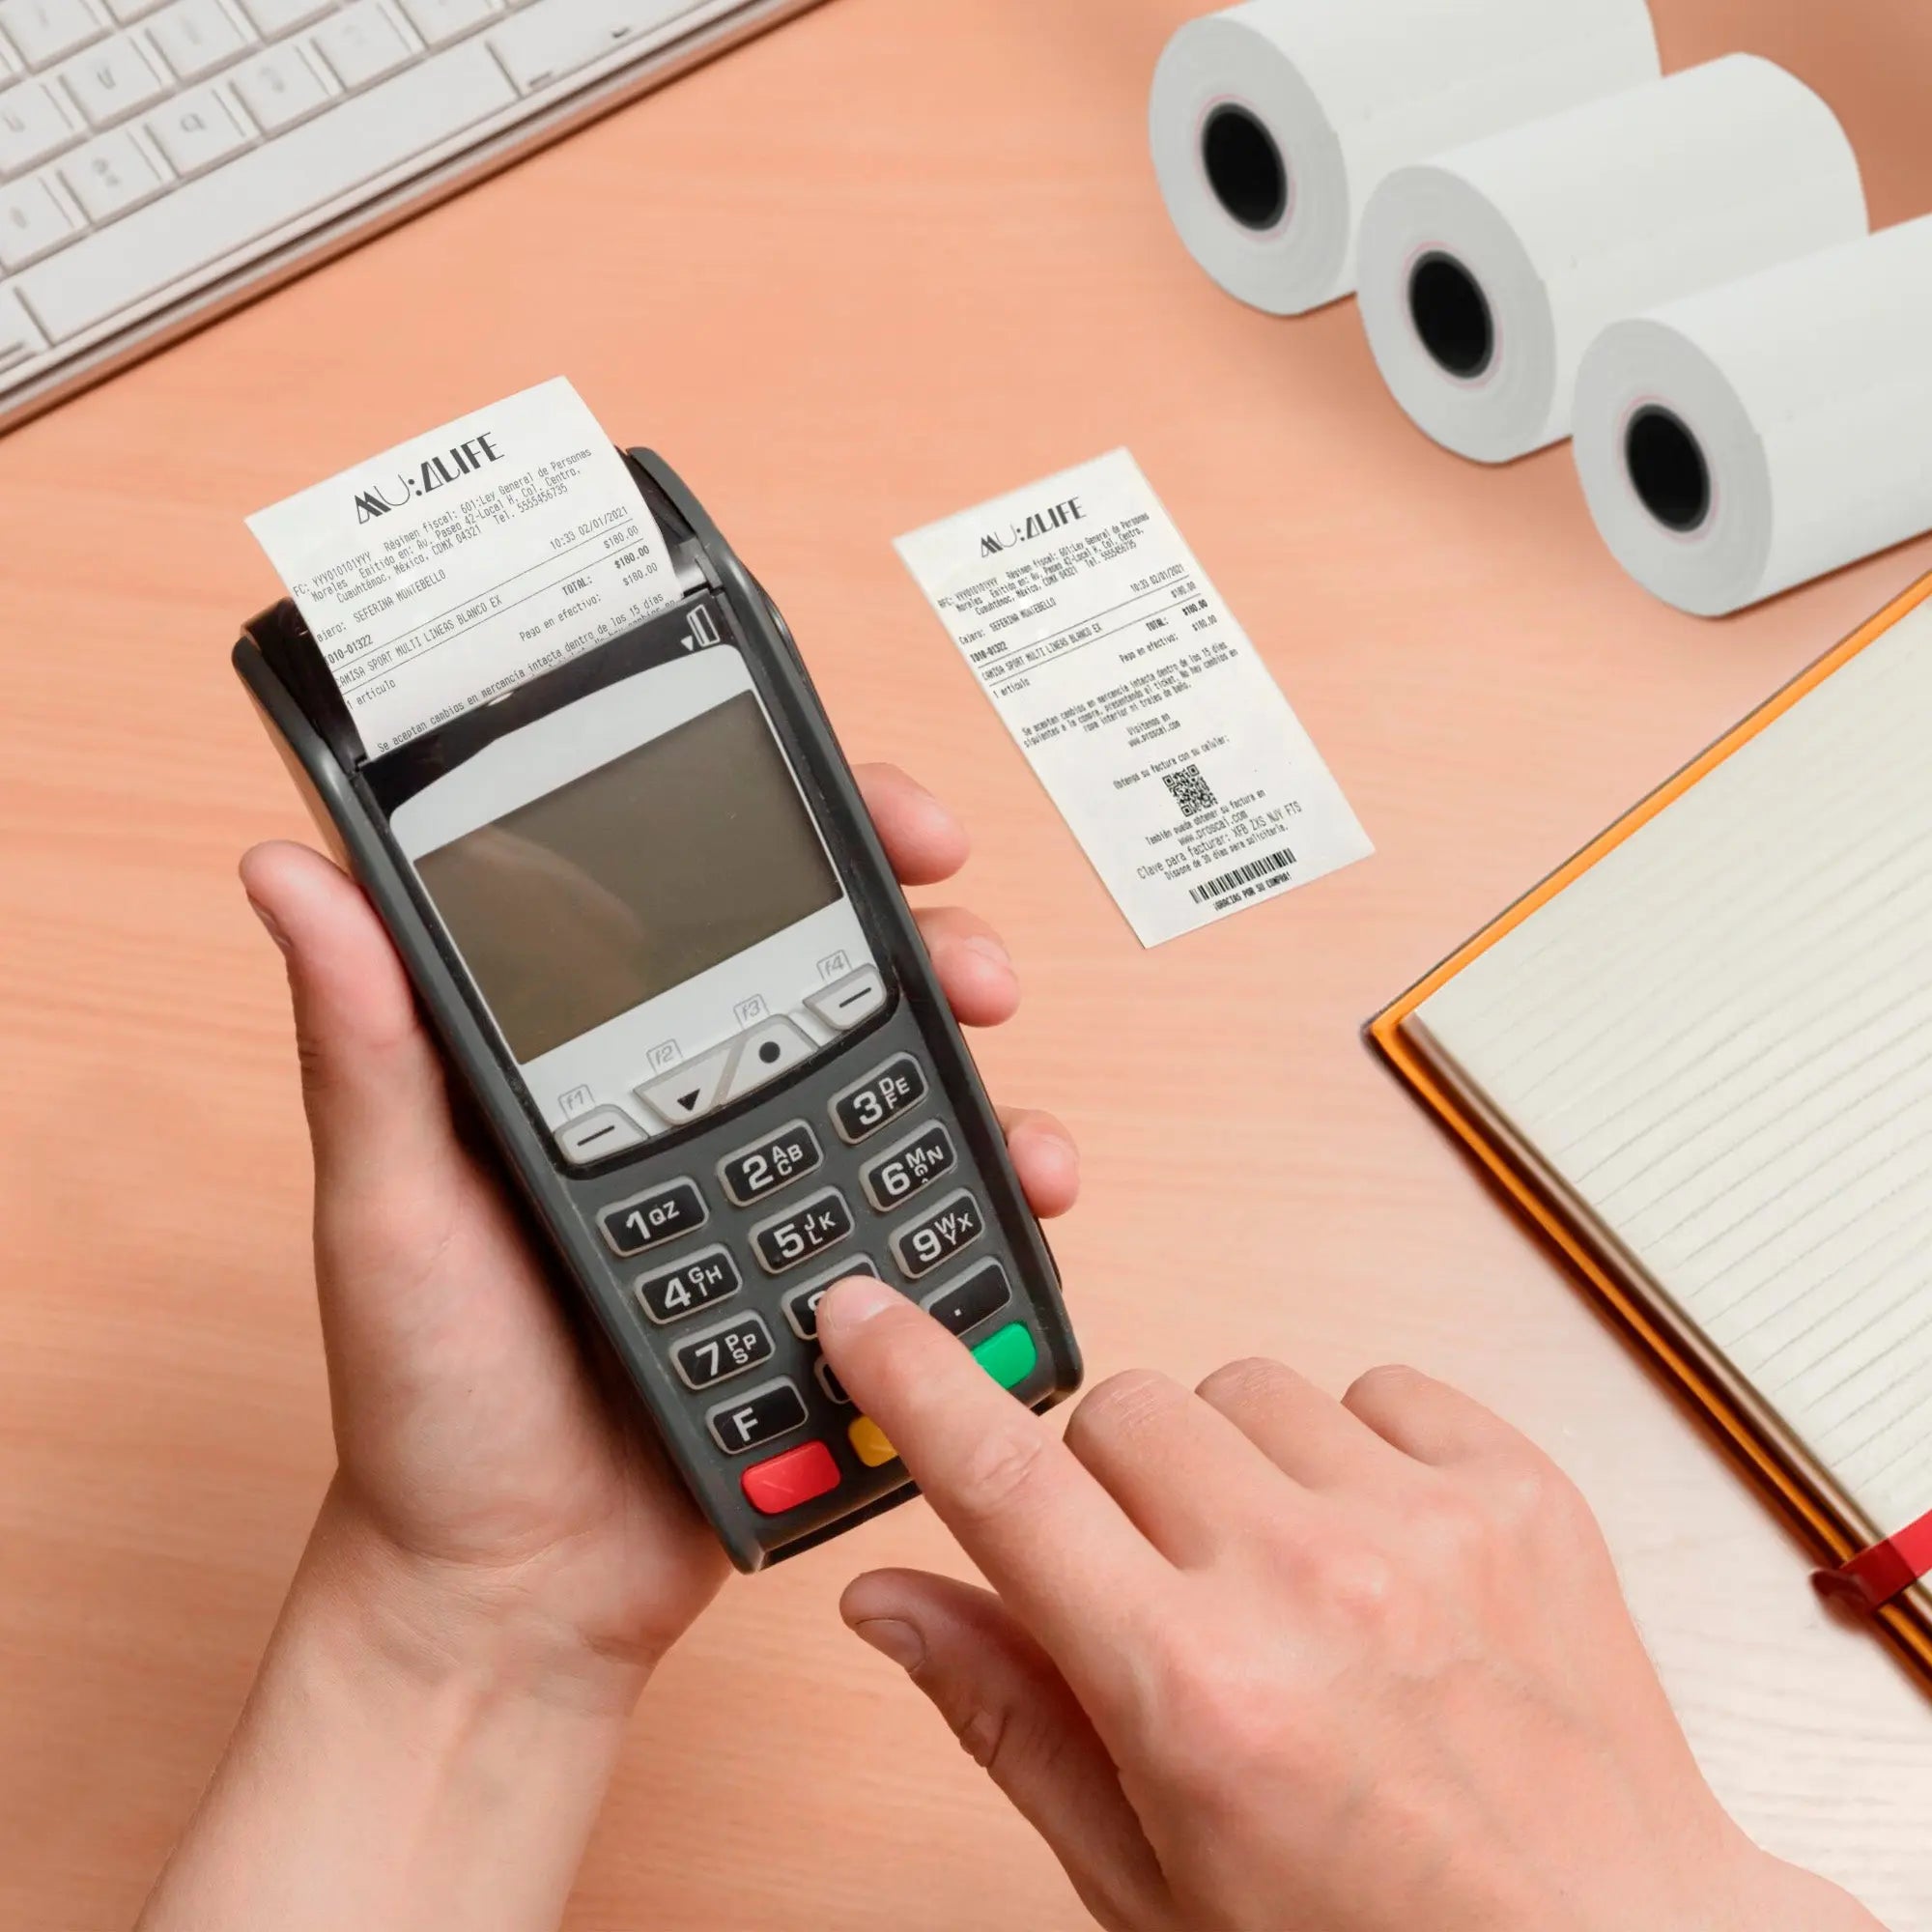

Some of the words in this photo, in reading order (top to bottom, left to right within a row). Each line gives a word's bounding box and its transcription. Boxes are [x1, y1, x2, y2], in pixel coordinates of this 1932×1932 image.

[309, 579, 348, 601] Morales
[358, 555, 395, 578] Emitido
[398, 546, 412, 558] en:
[416, 538, 432, 550] Av.
[435, 522, 462, 540] Paseo
[465, 499, 503, 525] 42-Local
[521, 484, 542, 498] Col.
[311, 551, 370, 586] YYY010101YYY
[422, 511, 457, 532] fiscal:
[460, 491, 497, 513] 601:Ley
[497, 471, 533, 496] General
[537, 467, 549, 477] de
[550, 449, 591, 470] Personas
[431, 537, 453, 554] CDMX
[455, 524, 480, 543] 04321
[493, 510, 514, 524] Tel.
[517, 482, 567, 512] 5555456735
[550, 530, 576, 549] 10:33
[578, 506, 627, 535] 02/01/2021
[603, 525, 638, 548] $180.00
[353, 596, 393, 622] SEFERINA
[395, 569, 445, 601] MONTEBELLO
[519, 625, 540, 640] Pago
[543, 618, 554, 628] en
[557, 594, 600, 621] efectivo:
[622, 562, 657, 585] $180.00
[561, 576, 592, 595] TOTAL:
[614, 545, 649, 568] $180.00
[367, 650, 391, 670] SPORT
[395, 636, 421, 656] MULTI
[423, 619, 454, 641] LINEAS
[456, 602, 487, 625] BLANCO
[489, 594, 501, 608] EX
[346, 699, 353, 709] 1
[377, 742, 392, 755] Se
[392, 722, 427, 747] aceptan
[430, 701, 464, 724] cambios
[467, 695, 479, 704] en
[527, 649, 562, 674] intacta
[564, 632, 594, 652] dentro
[597, 624, 609, 634] de
[610, 614, 626, 626] los
[629, 604, 639, 616] 15
[732, 1406, 758, 1441] F
